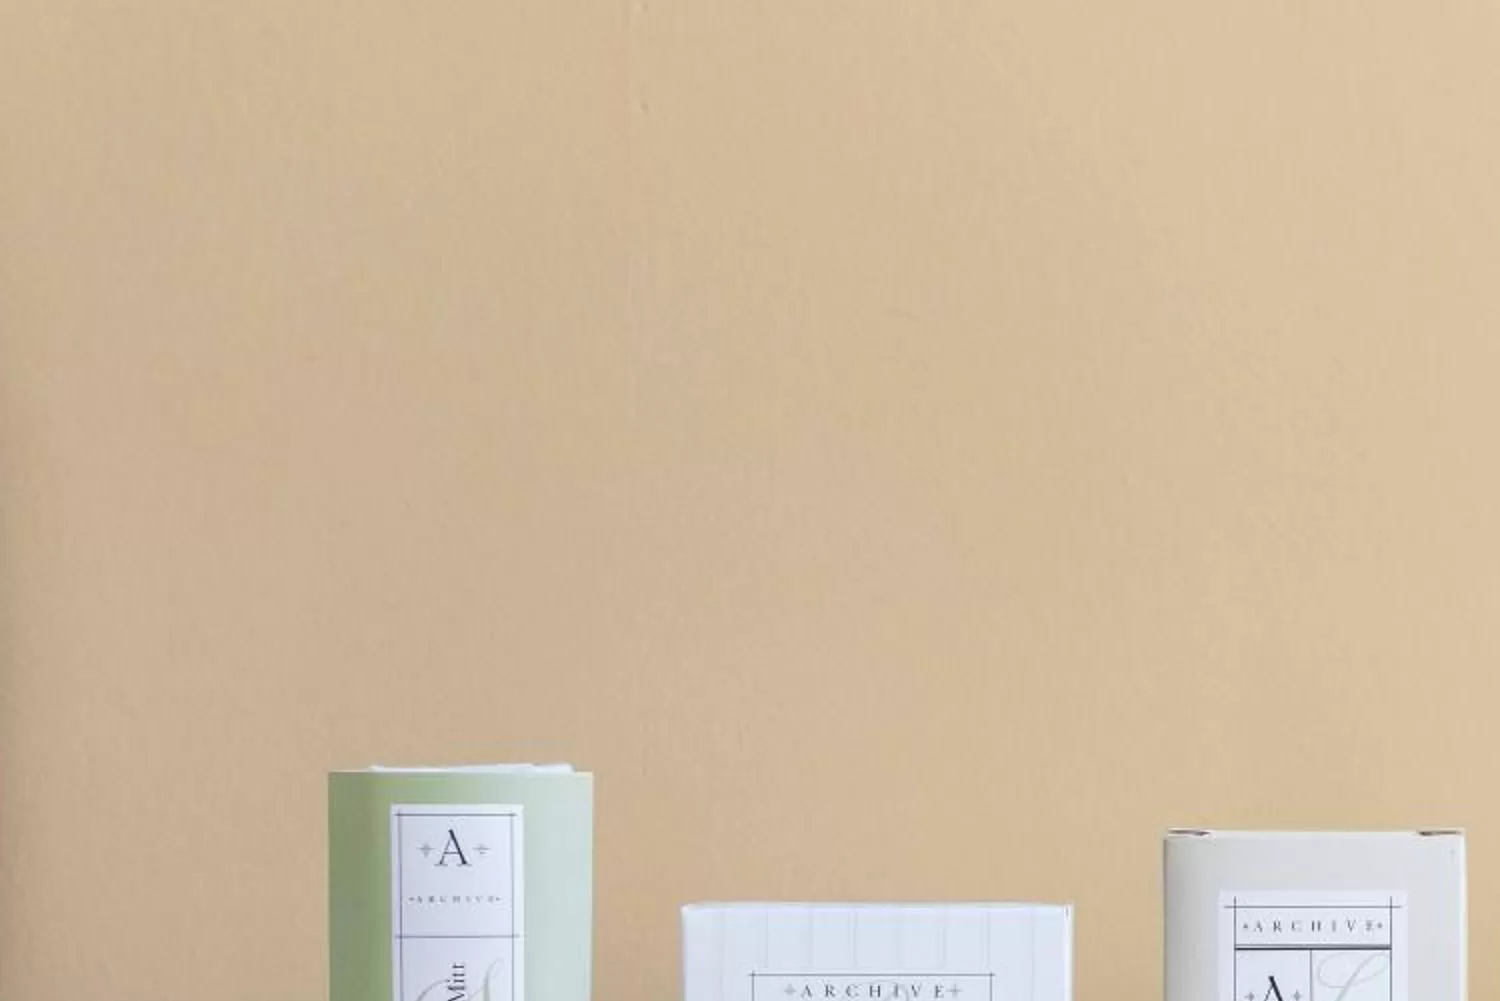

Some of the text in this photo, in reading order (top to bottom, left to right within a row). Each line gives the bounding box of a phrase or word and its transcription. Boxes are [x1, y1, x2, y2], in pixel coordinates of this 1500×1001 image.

[434, 829, 472, 867] A
[1253, 919, 1376, 933] ARCHIVE
[800, 984, 946, 999] ARCHIVE
